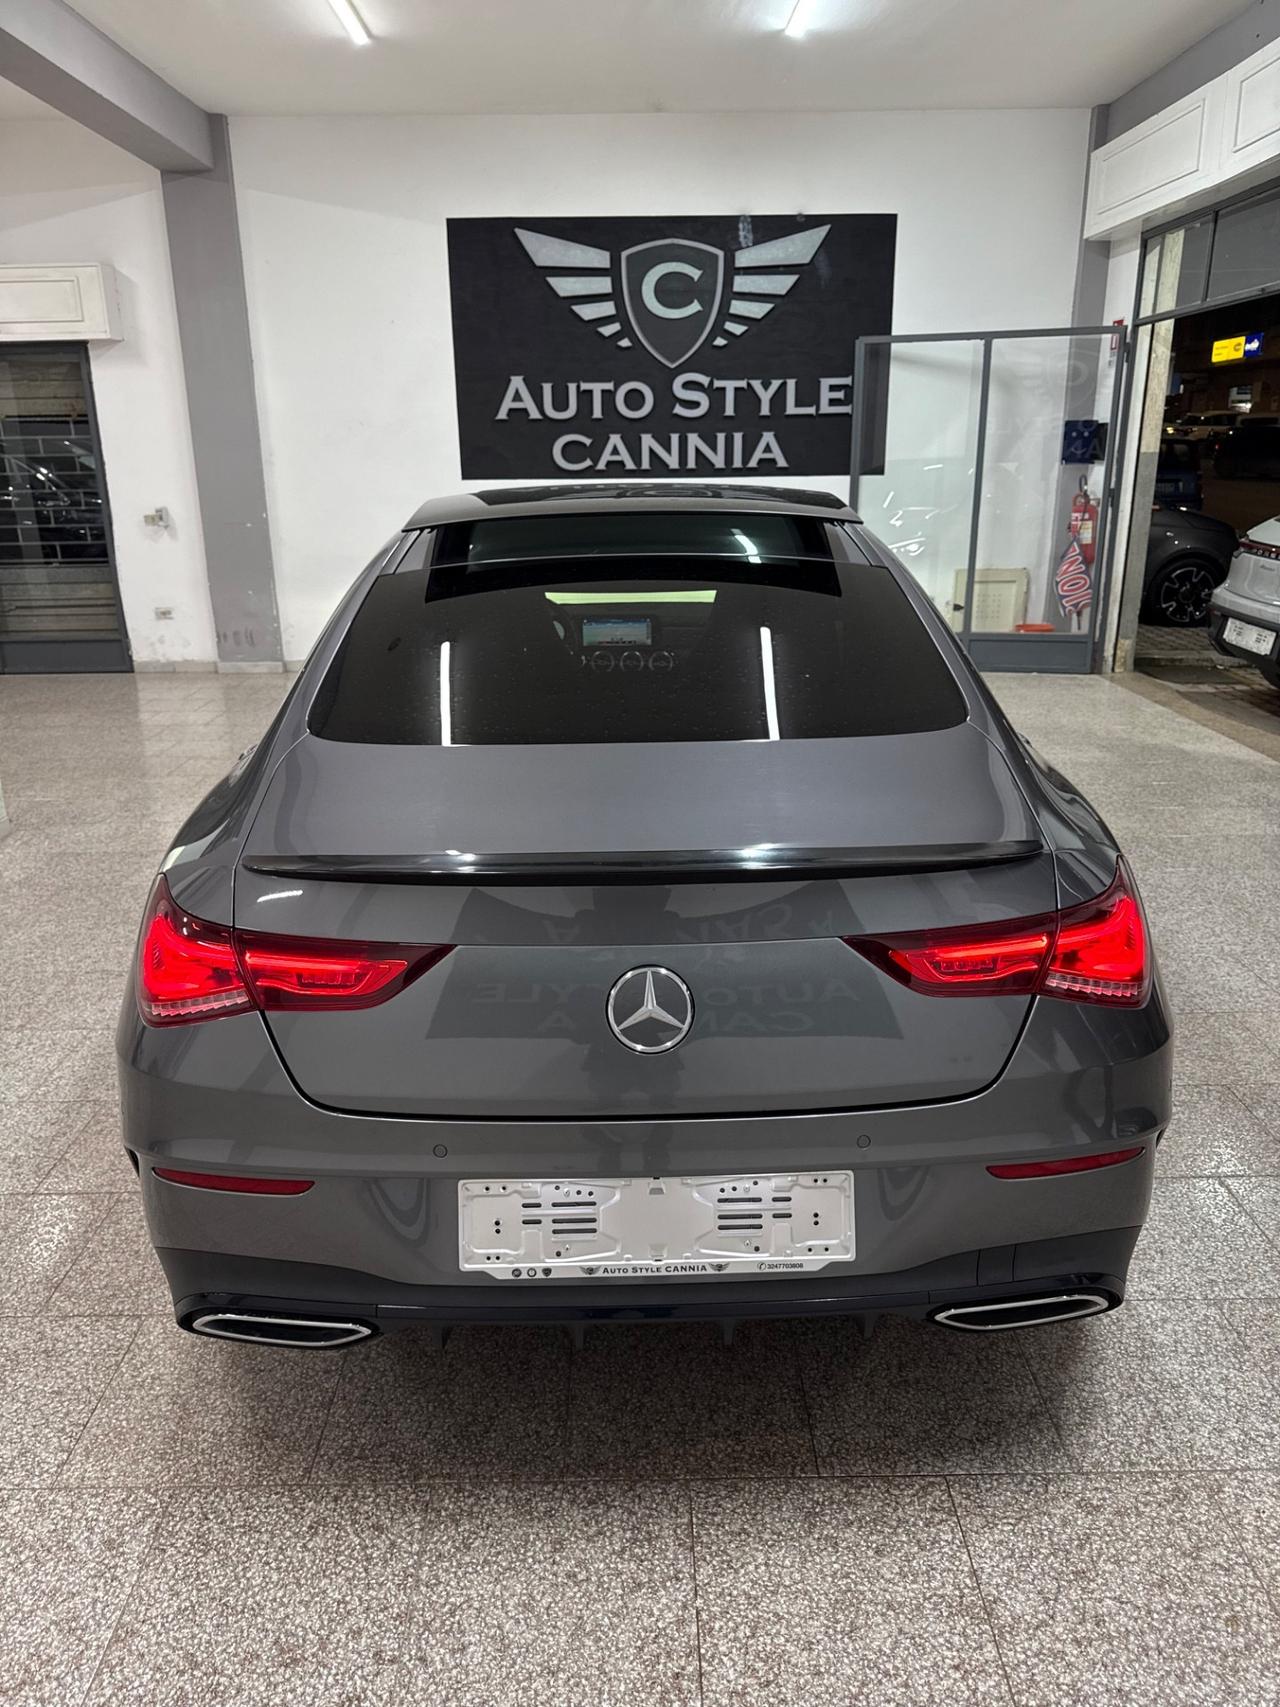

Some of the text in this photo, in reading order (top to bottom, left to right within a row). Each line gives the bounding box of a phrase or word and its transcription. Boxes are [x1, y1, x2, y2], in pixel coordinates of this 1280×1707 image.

[641, 261, 704, 319] C
[495, 372, 853, 420] AUTO STYLE
[552, 431, 790, 471] CANNIA
[602, 1264, 707, 1274] AUTO STYLE CANNIA
